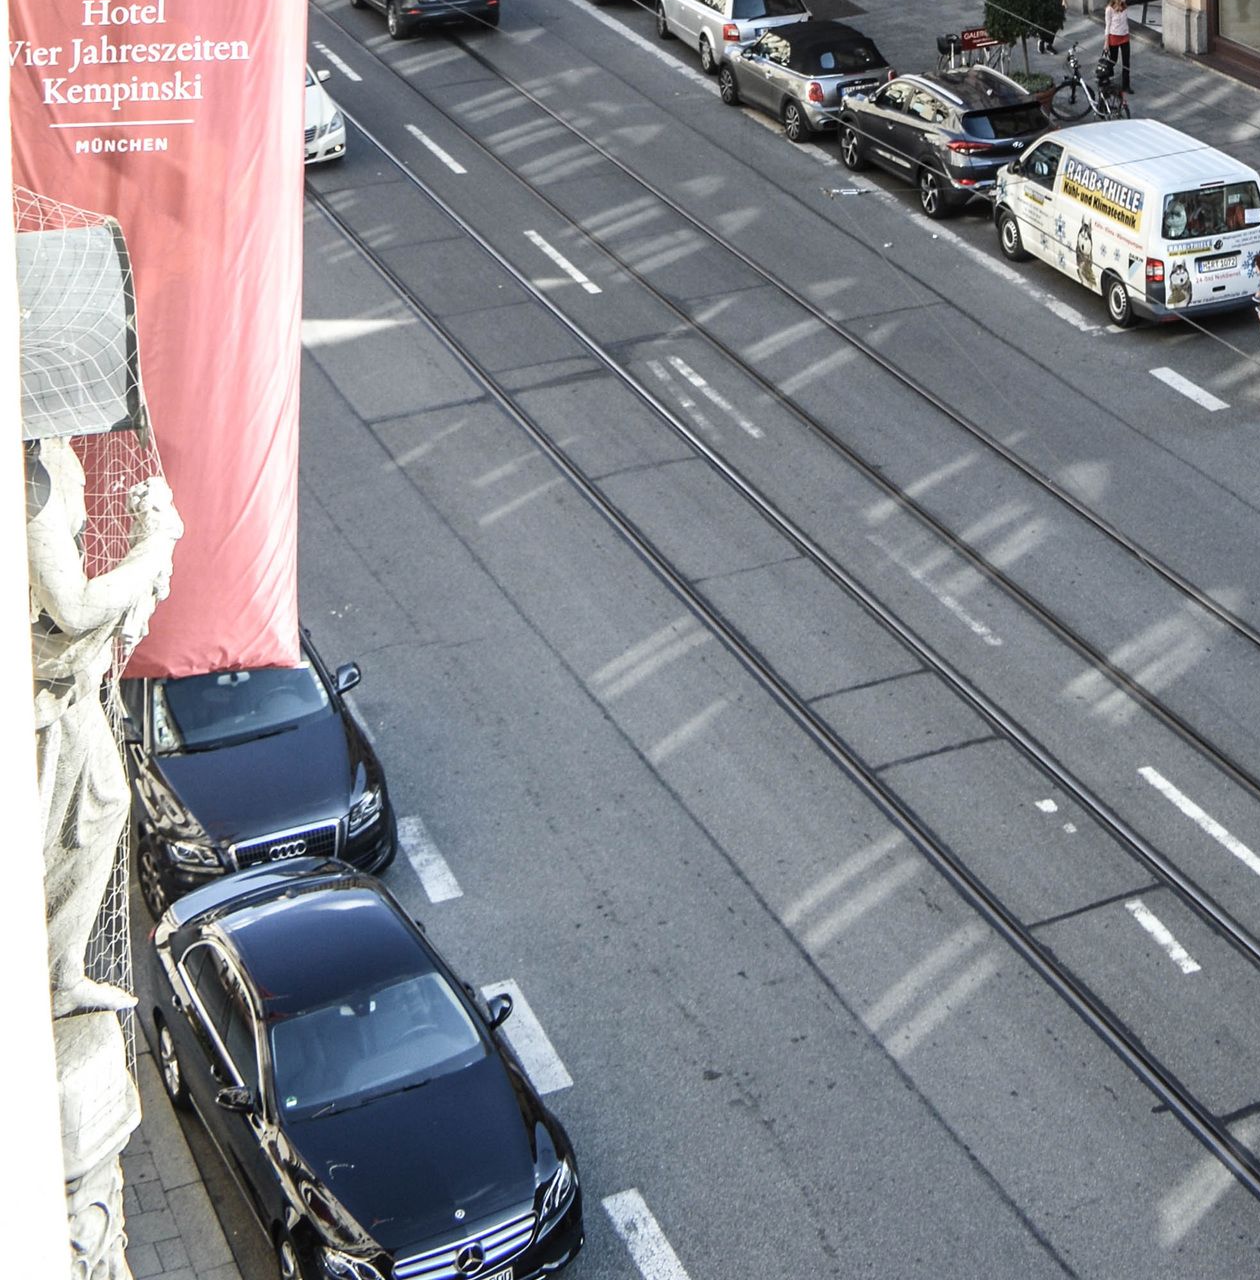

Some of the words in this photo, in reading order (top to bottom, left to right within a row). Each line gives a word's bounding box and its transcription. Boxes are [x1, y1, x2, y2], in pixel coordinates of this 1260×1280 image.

[8, 41, 62, 66] Vier
[68, 35, 250, 73] Jahreszeiten
[43, 71, 203, 111] Kempinski
[75, 137, 168, 154] MÜNCHEN
[1066, 159, 1141, 214] RAAB+THIELE
[1080, 192, 1092, 206] und
[1092, 196, 1137, 229] Klimatechnik
